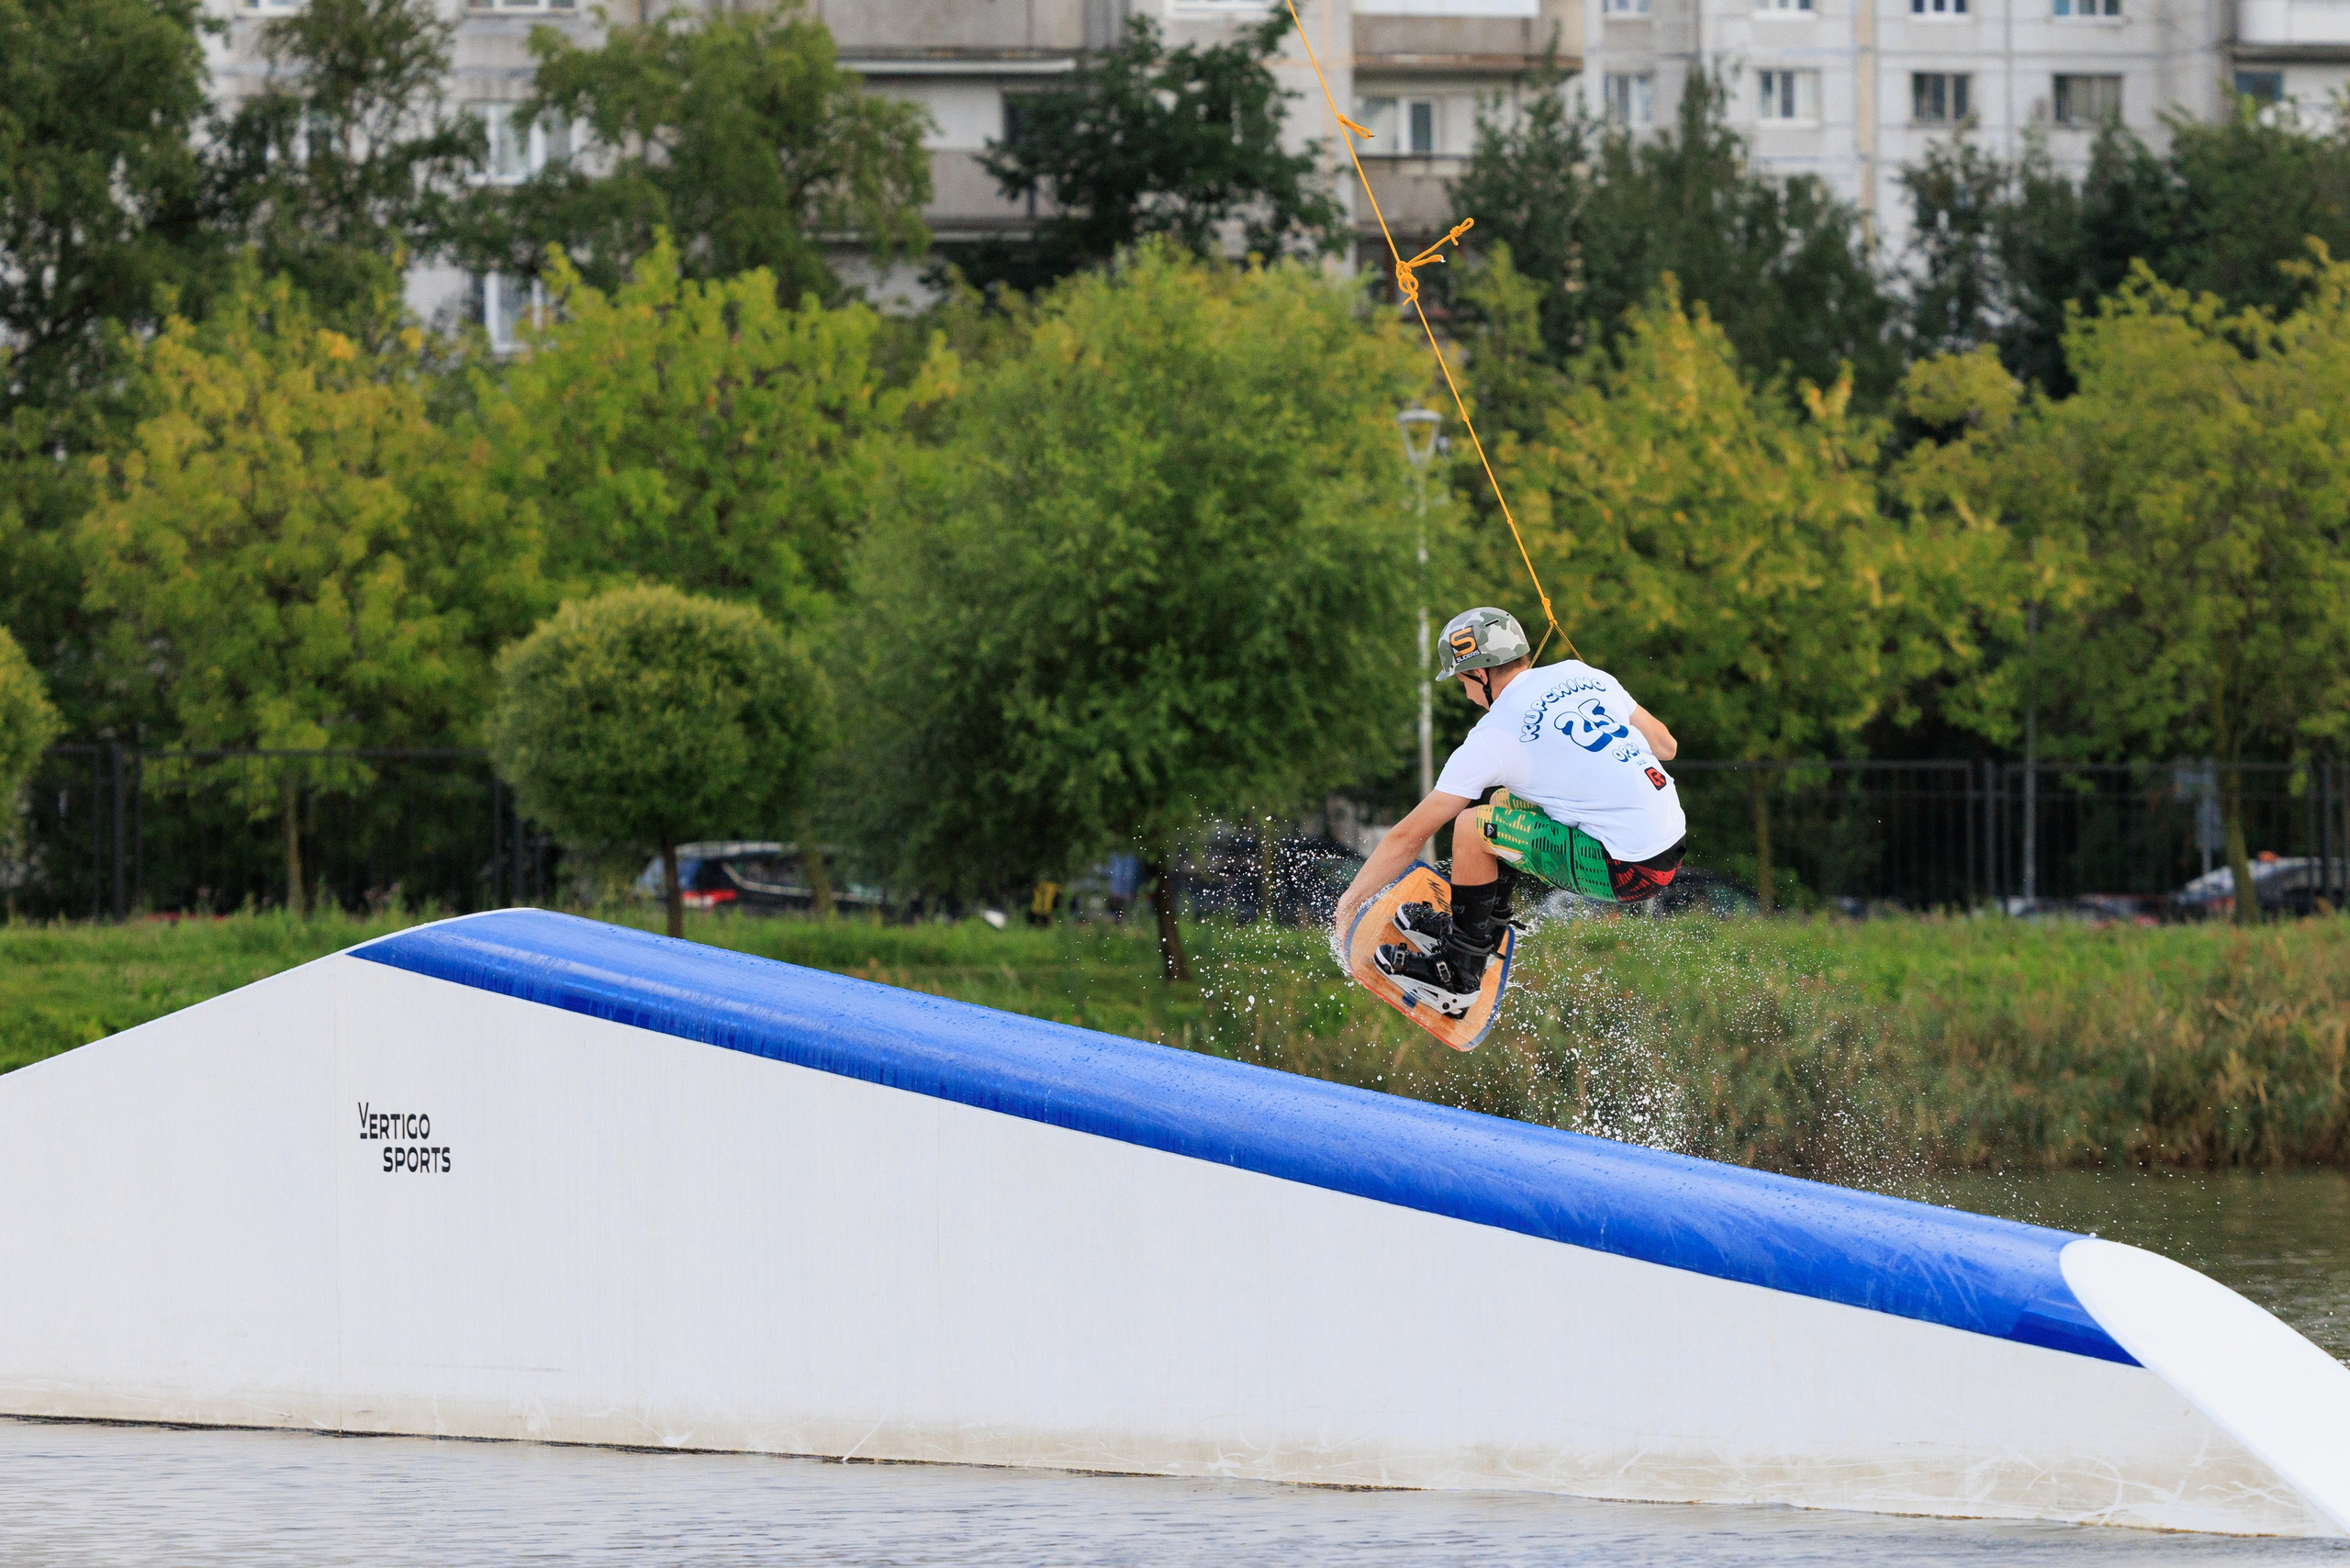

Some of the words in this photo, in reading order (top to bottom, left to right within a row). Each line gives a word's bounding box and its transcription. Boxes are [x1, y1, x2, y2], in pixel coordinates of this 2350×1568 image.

[1519, 677, 1606, 743] KUPCHINO
[1554, 699, 1628, 752] 25
[357, 1102, 431, 1139] VERTIGO
[383, 1147, 451, 1173] SPORTS
